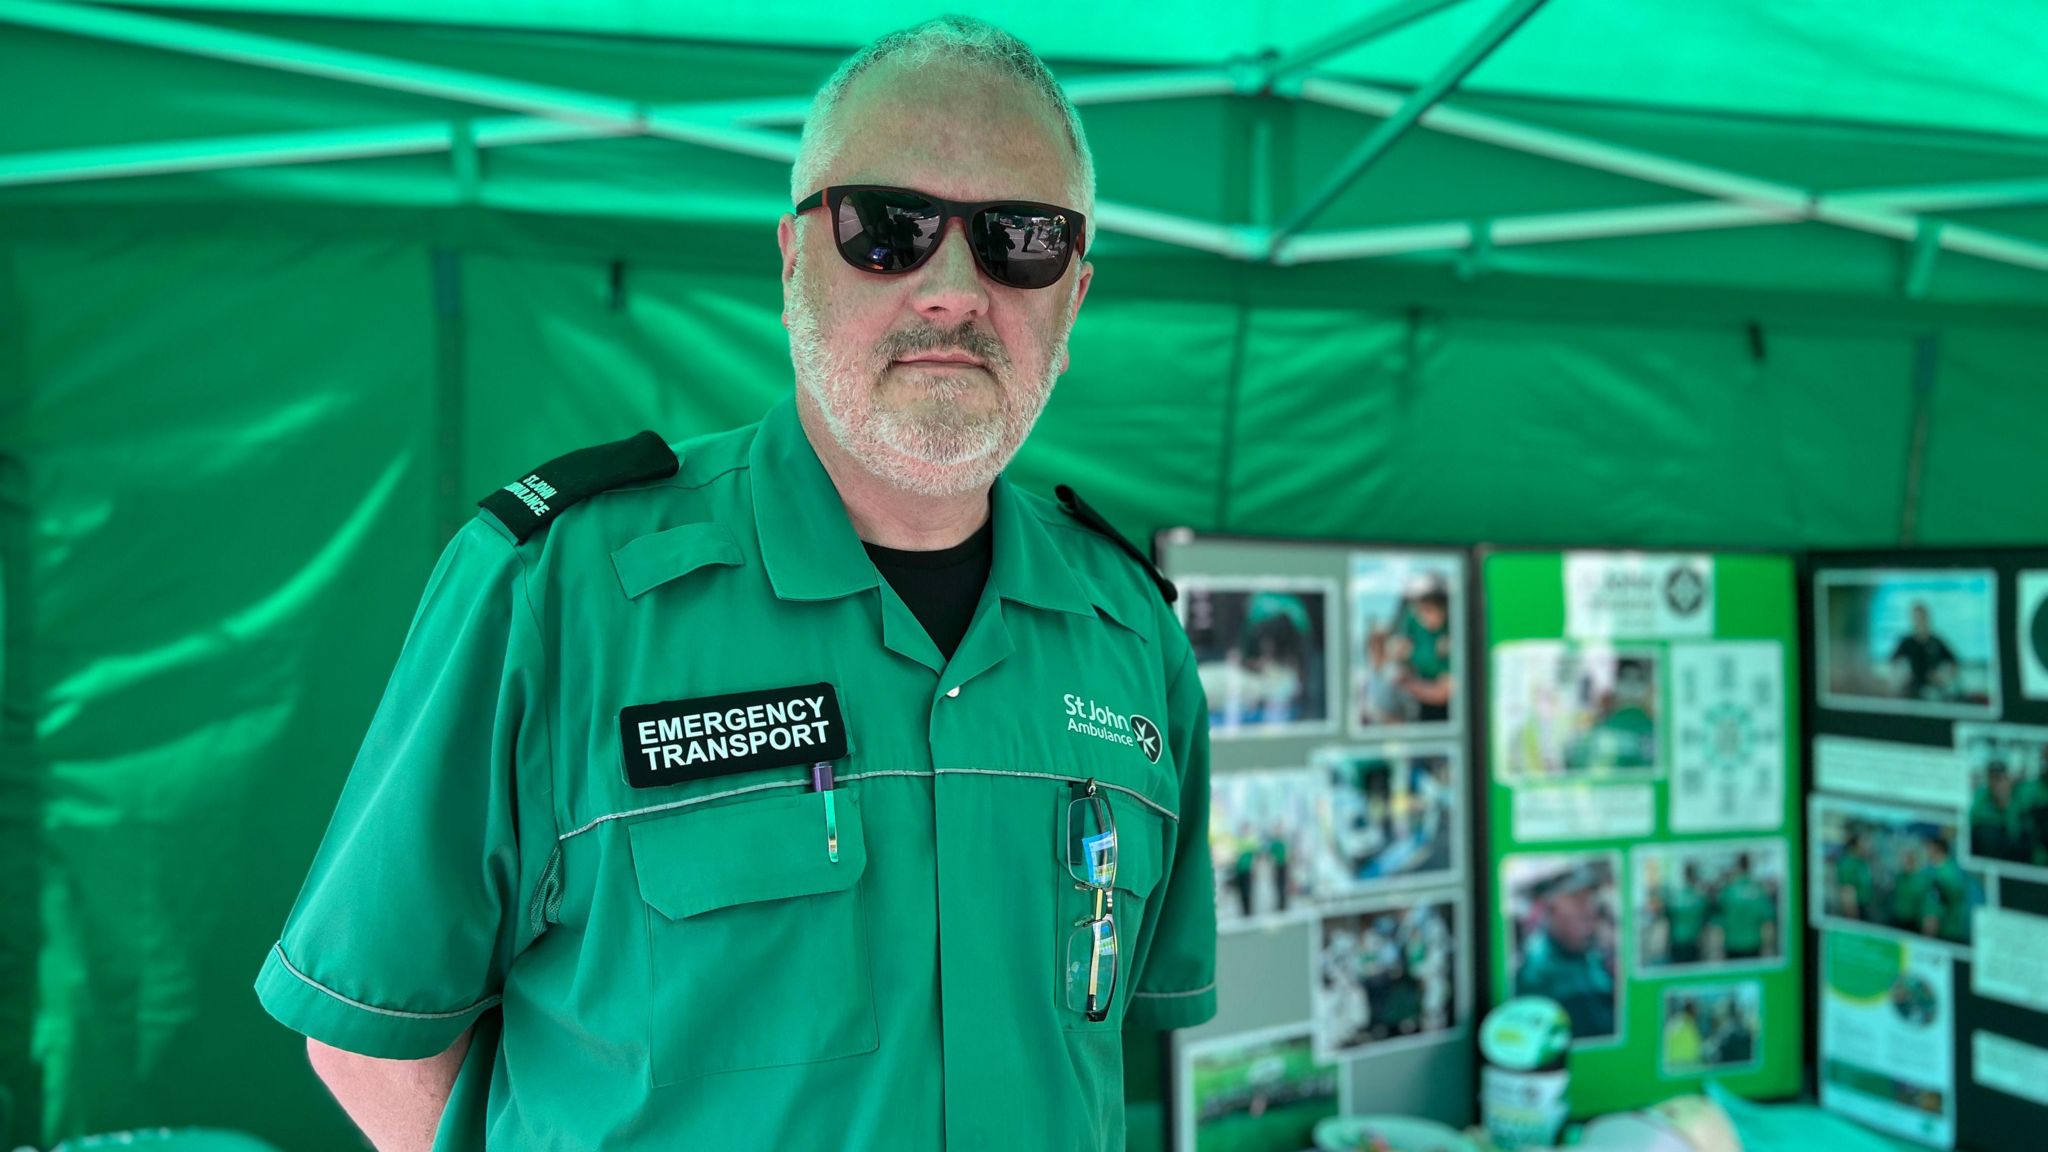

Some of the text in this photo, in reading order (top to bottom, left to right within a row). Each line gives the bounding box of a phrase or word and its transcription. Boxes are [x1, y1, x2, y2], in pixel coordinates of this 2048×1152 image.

[638, 696, 824, 745] EMERGENCY
[1064, 693, 1130, 732] St John
[1067, 717, 1134, 747] Ambulance
[642, 720, 829, 771] TRANSPORT
